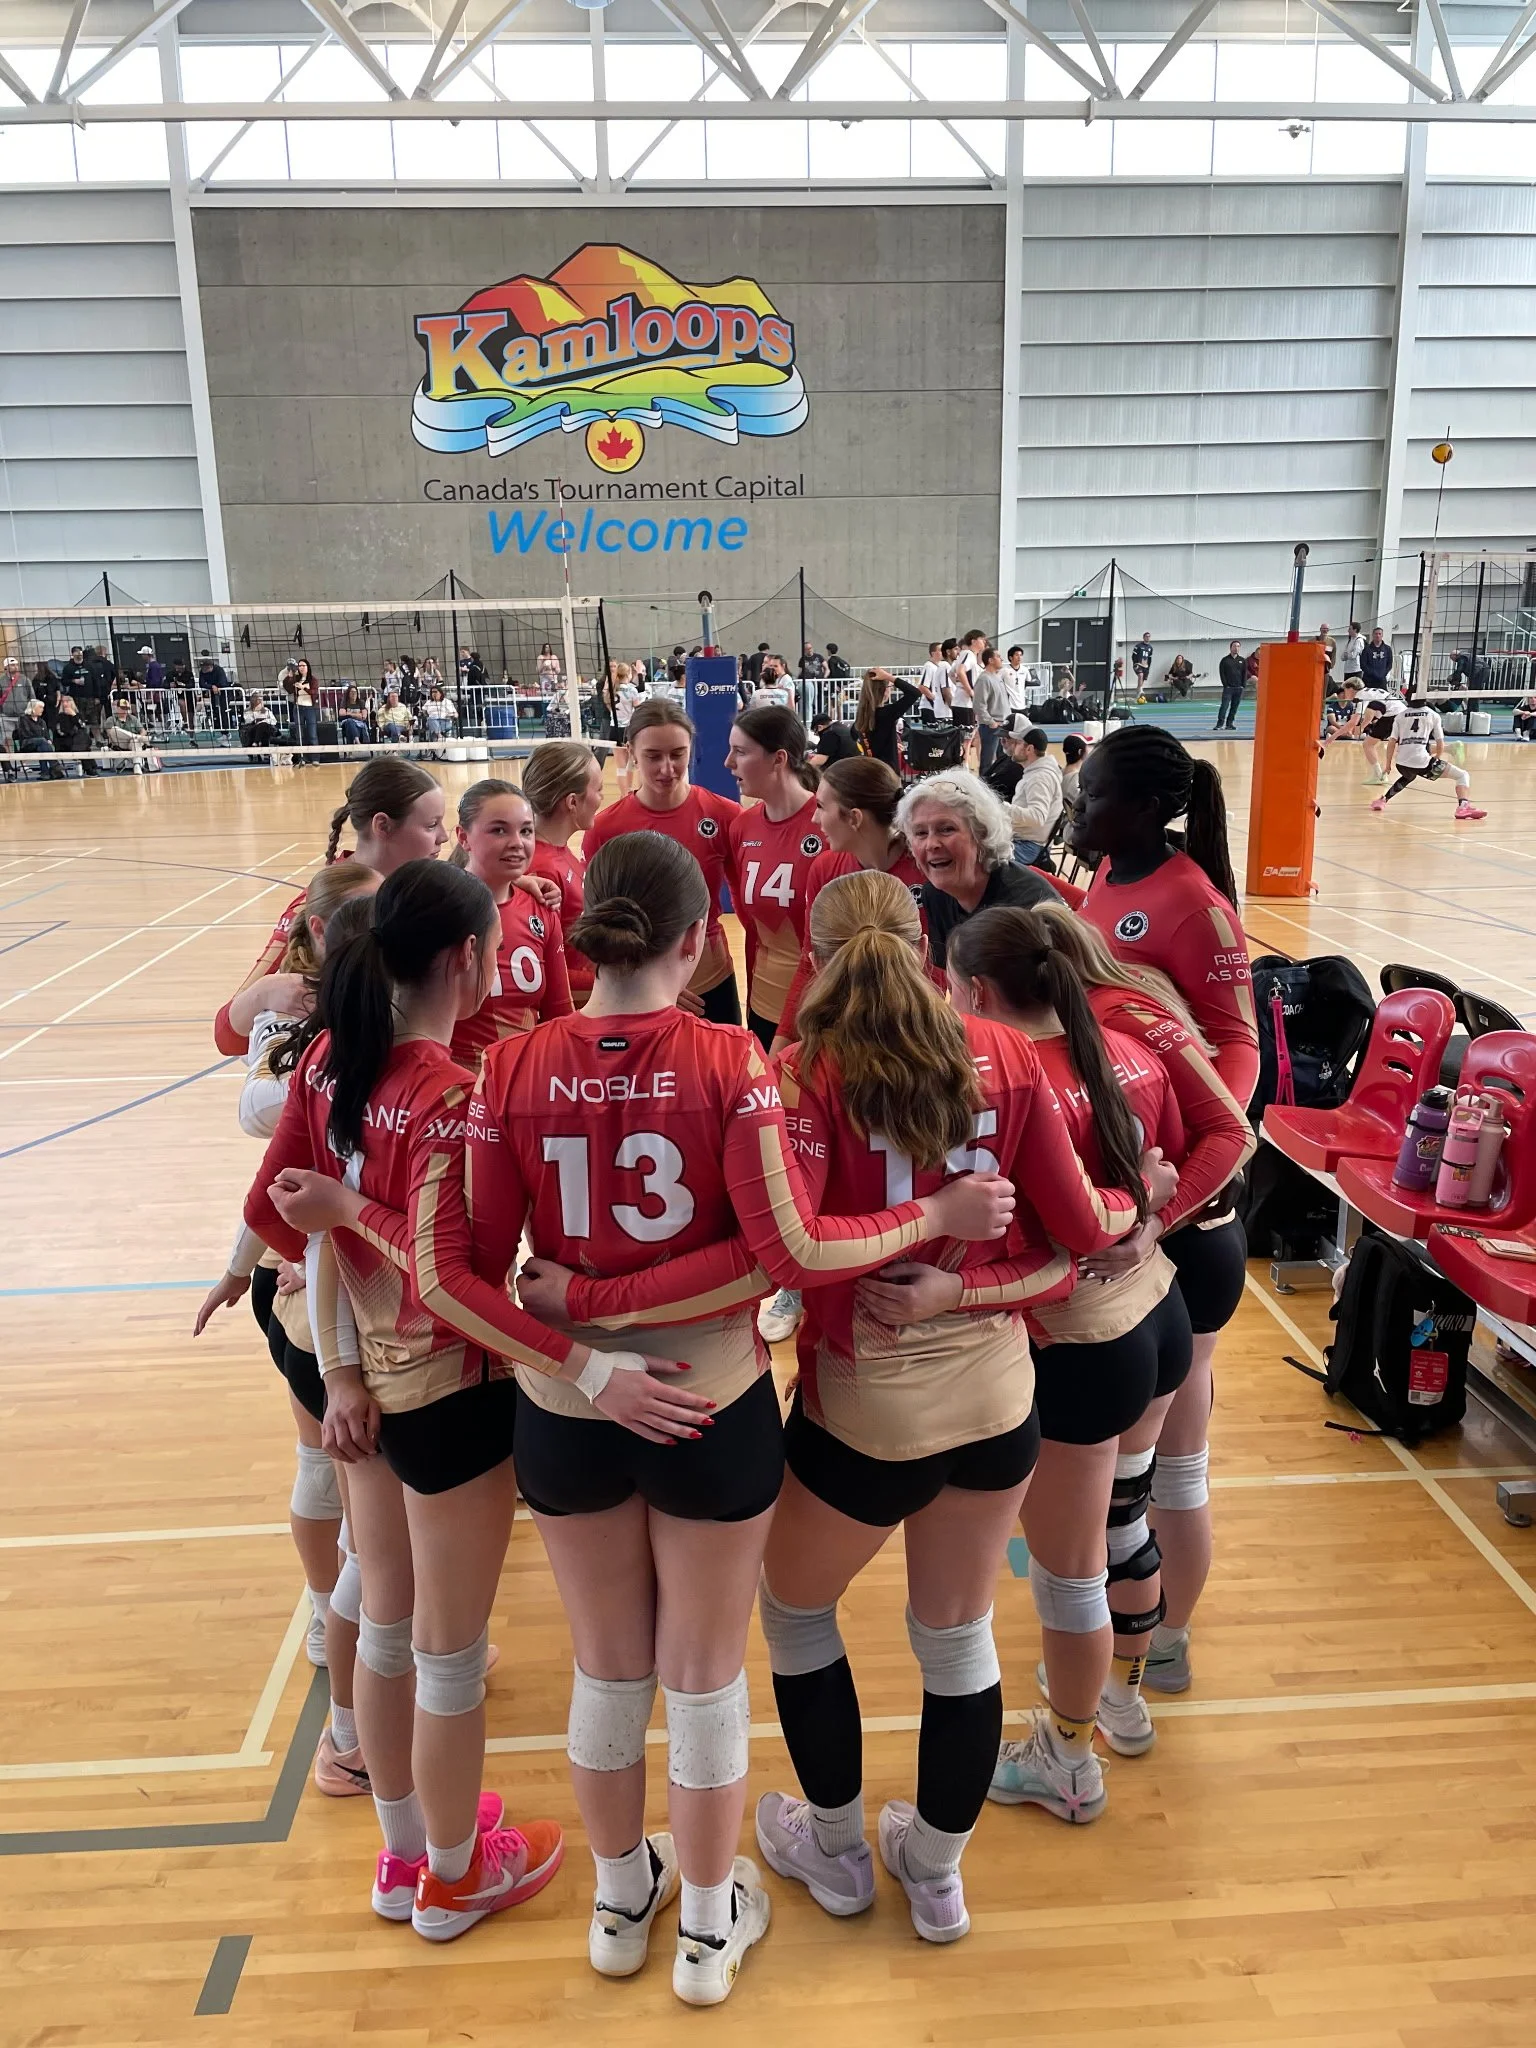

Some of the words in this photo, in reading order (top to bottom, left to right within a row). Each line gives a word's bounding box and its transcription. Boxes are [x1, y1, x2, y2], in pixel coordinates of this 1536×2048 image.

[416, 294, 795, 395] Kamloops
[423, 478, 539, 500] Canada's
[544, 478, 708, 500] Tournament
[715, 474, 804, 502] Capital
[488, 508, 748, 554] Welcome
[1410, 718, 1420, 733] 4
[744, 861, 795, 908] 14
[1214, 952, 1248, 966] RISE
[1205, 969, 1232, 983] AS
[1236, 968, 1252, 980] ON
[1145, 1020, 1178, 1041] RISE
[1172, 1029, 1191, 1043] ON
[305, 1064, 411, 1134] COCANE
[549, 1071, 676, 1103] NOBLE
[736, 1085, 782, 1114] JVA
[468, 1101, 486, 1119] SE
[784, 1116, 812, 1134] SE
[541, 1131, 696, 1243] 13
